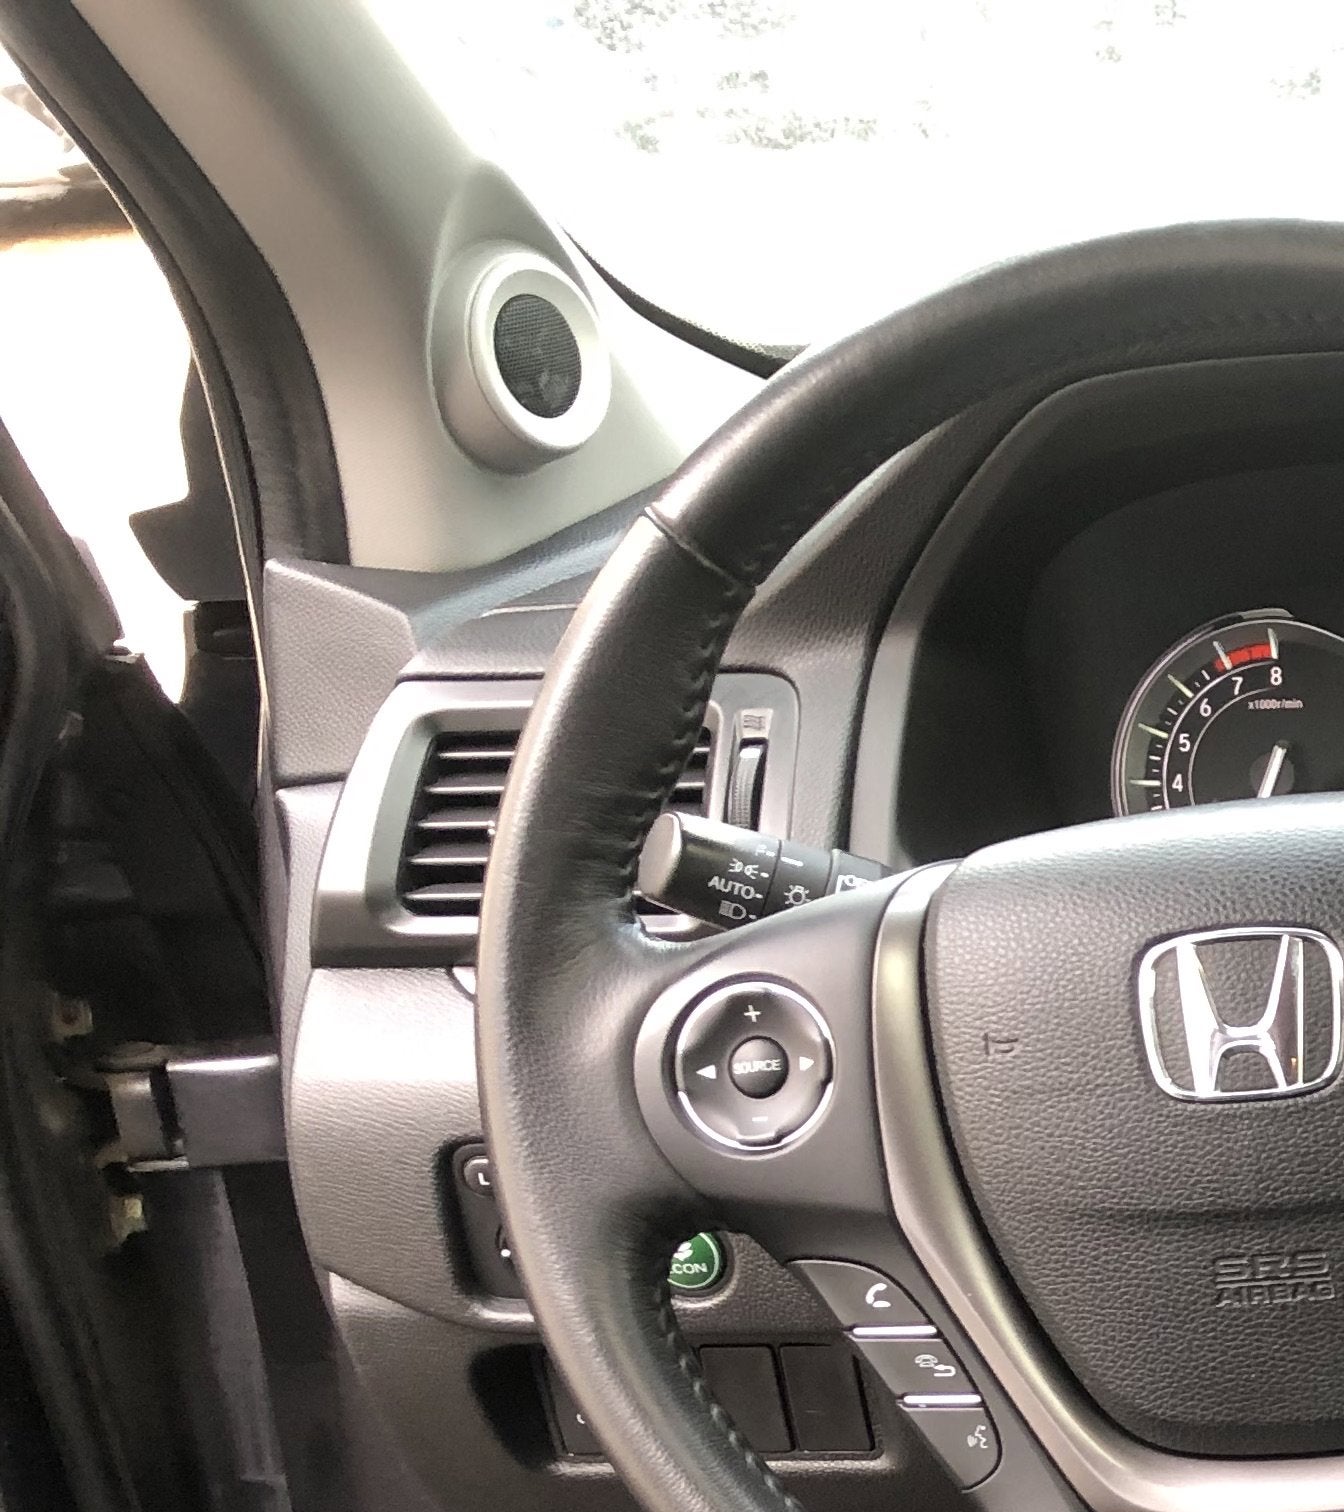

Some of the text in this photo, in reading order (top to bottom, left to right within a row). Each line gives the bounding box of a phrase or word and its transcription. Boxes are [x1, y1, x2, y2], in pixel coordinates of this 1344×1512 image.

[1270, 666, 1282, 686] 8
[1232, 676, 1243, 696] 7
[1200, 698, 1212, 717] 6
[1179, 733, 1191, 752] 5
[1172, 773, 1184, 793] 4
[707, 875, 756, 900] AUTO
[733, 1058, 782, 1075] SOURCE
[670, 1262, 708, 1275] CON
